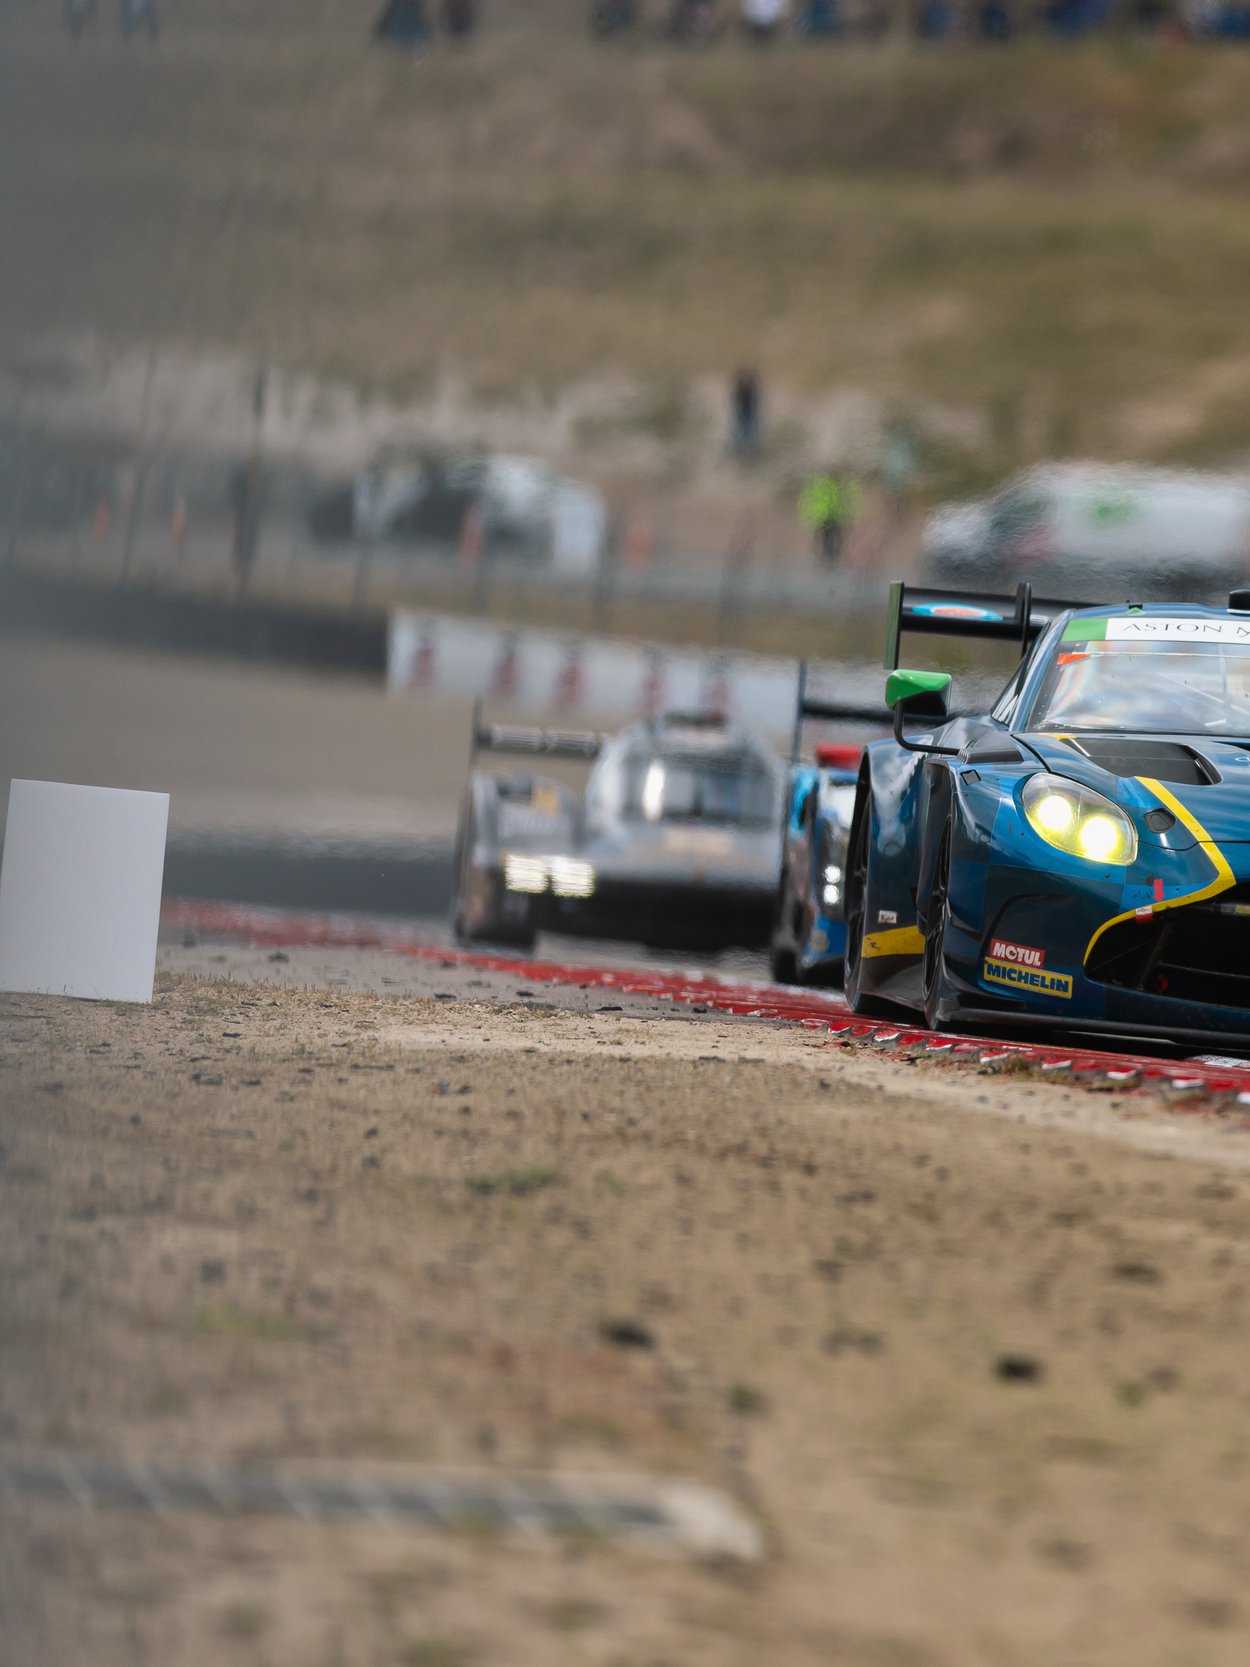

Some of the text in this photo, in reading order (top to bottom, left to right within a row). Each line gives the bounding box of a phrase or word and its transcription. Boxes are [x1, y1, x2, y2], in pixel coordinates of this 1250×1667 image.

[1124, 622, 1222, 633] ASTON
[992, 942, 1041, 966] MOTUL
[986, 962, 1069, 993] MICHELIN
